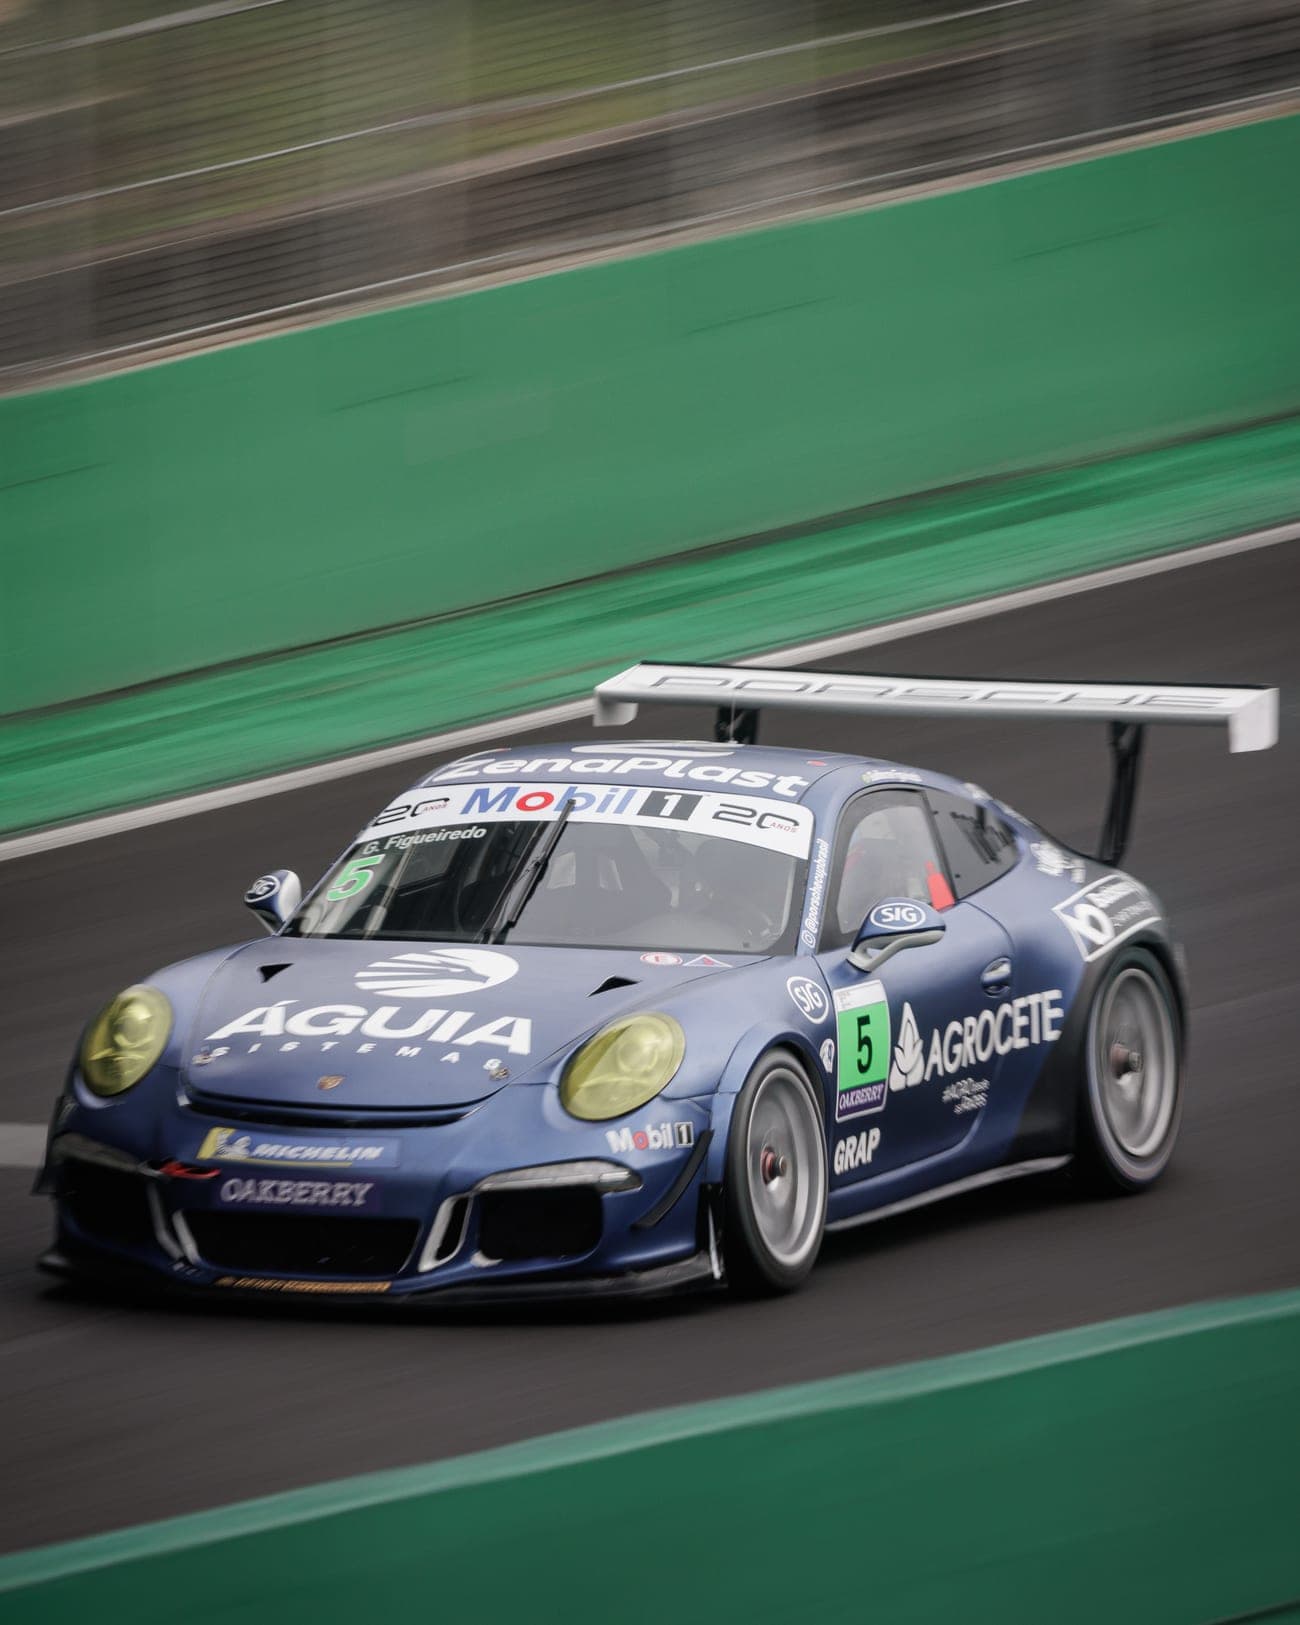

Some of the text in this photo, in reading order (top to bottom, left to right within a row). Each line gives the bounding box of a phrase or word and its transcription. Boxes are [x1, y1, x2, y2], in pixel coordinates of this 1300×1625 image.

[432, 757, 809, 797] ZenaPlast
[460, 786, 637, 815] Mobil
[384, 826, 487, 850] Figueiredo
[326, 854, 385, 902] 5
[880, 906, 919, 923] SIG
[794, 982, 823, 1013] SIG
[204, 1000, 533, 1055] ÁGUIA
[924, 989, 1064, 1081] AGROCETE
[856, 1015, 873, 1074] 5
[839, 1083, 885, 1110] OAKBERRY
[252, 1143, 384, 1160] MICHELIN
[605, 1122, 674, 1154] Mobil
[833, 1128, 880, 1175] GRAP
[220, 1178, 374, 1206] OAKBERRY
